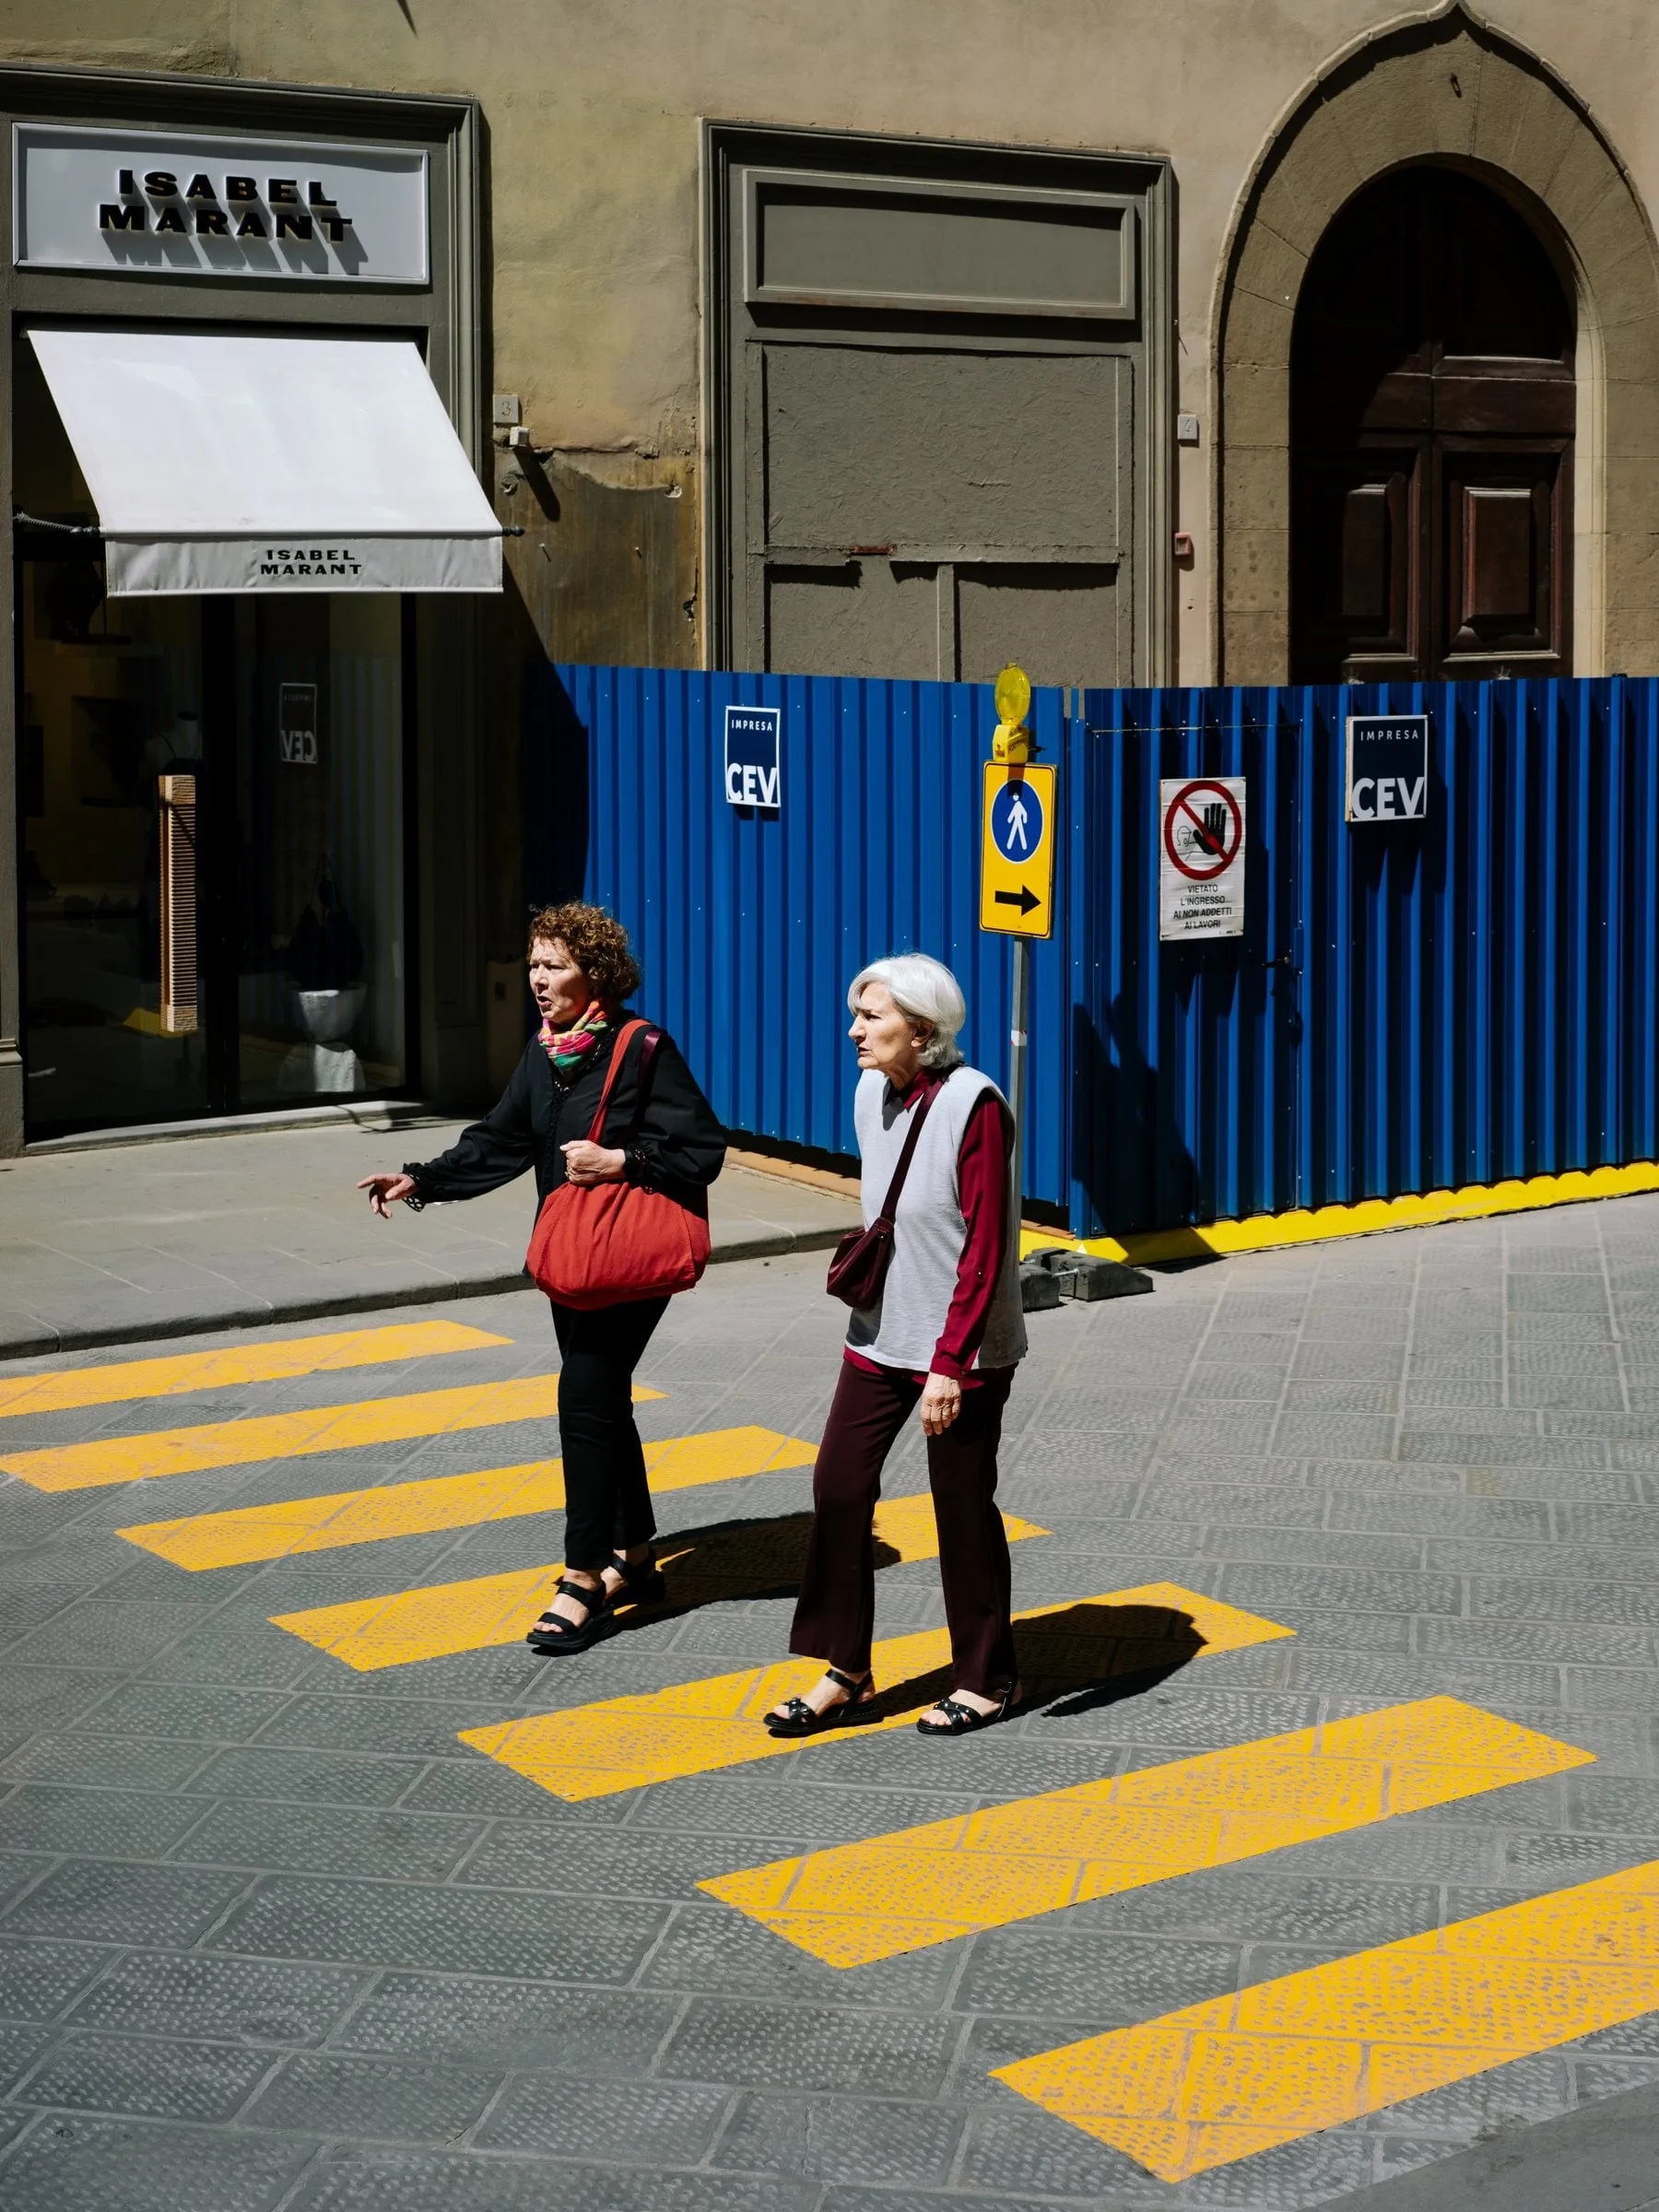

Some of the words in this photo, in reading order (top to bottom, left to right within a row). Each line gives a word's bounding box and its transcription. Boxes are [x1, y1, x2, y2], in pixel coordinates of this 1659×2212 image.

[119, 170, 337, 206] ISABEL
[99, 205, 352, 241] MARANT
[501, 400, 511, 416] 3
[266, 549, 355, 560] ISABEL
[260, 564, 361, 574] MARANT
[731, 719, 772, 731] IMPRESA
[1360, 730, 1419, 741] IMPRESA
[727, 762, 778, 804] CEV
[1351, 777, 1425, 818] CEV
[1188, 885, 1218, 893] VIETATO
[1181, 896, 1225, 906] L'INGRESSO
[1182, 909, 1198, 918] NON
[1200, 907, 1231, 916] ADDETTI
[1194, 920, 1220, 929] LAVORI
